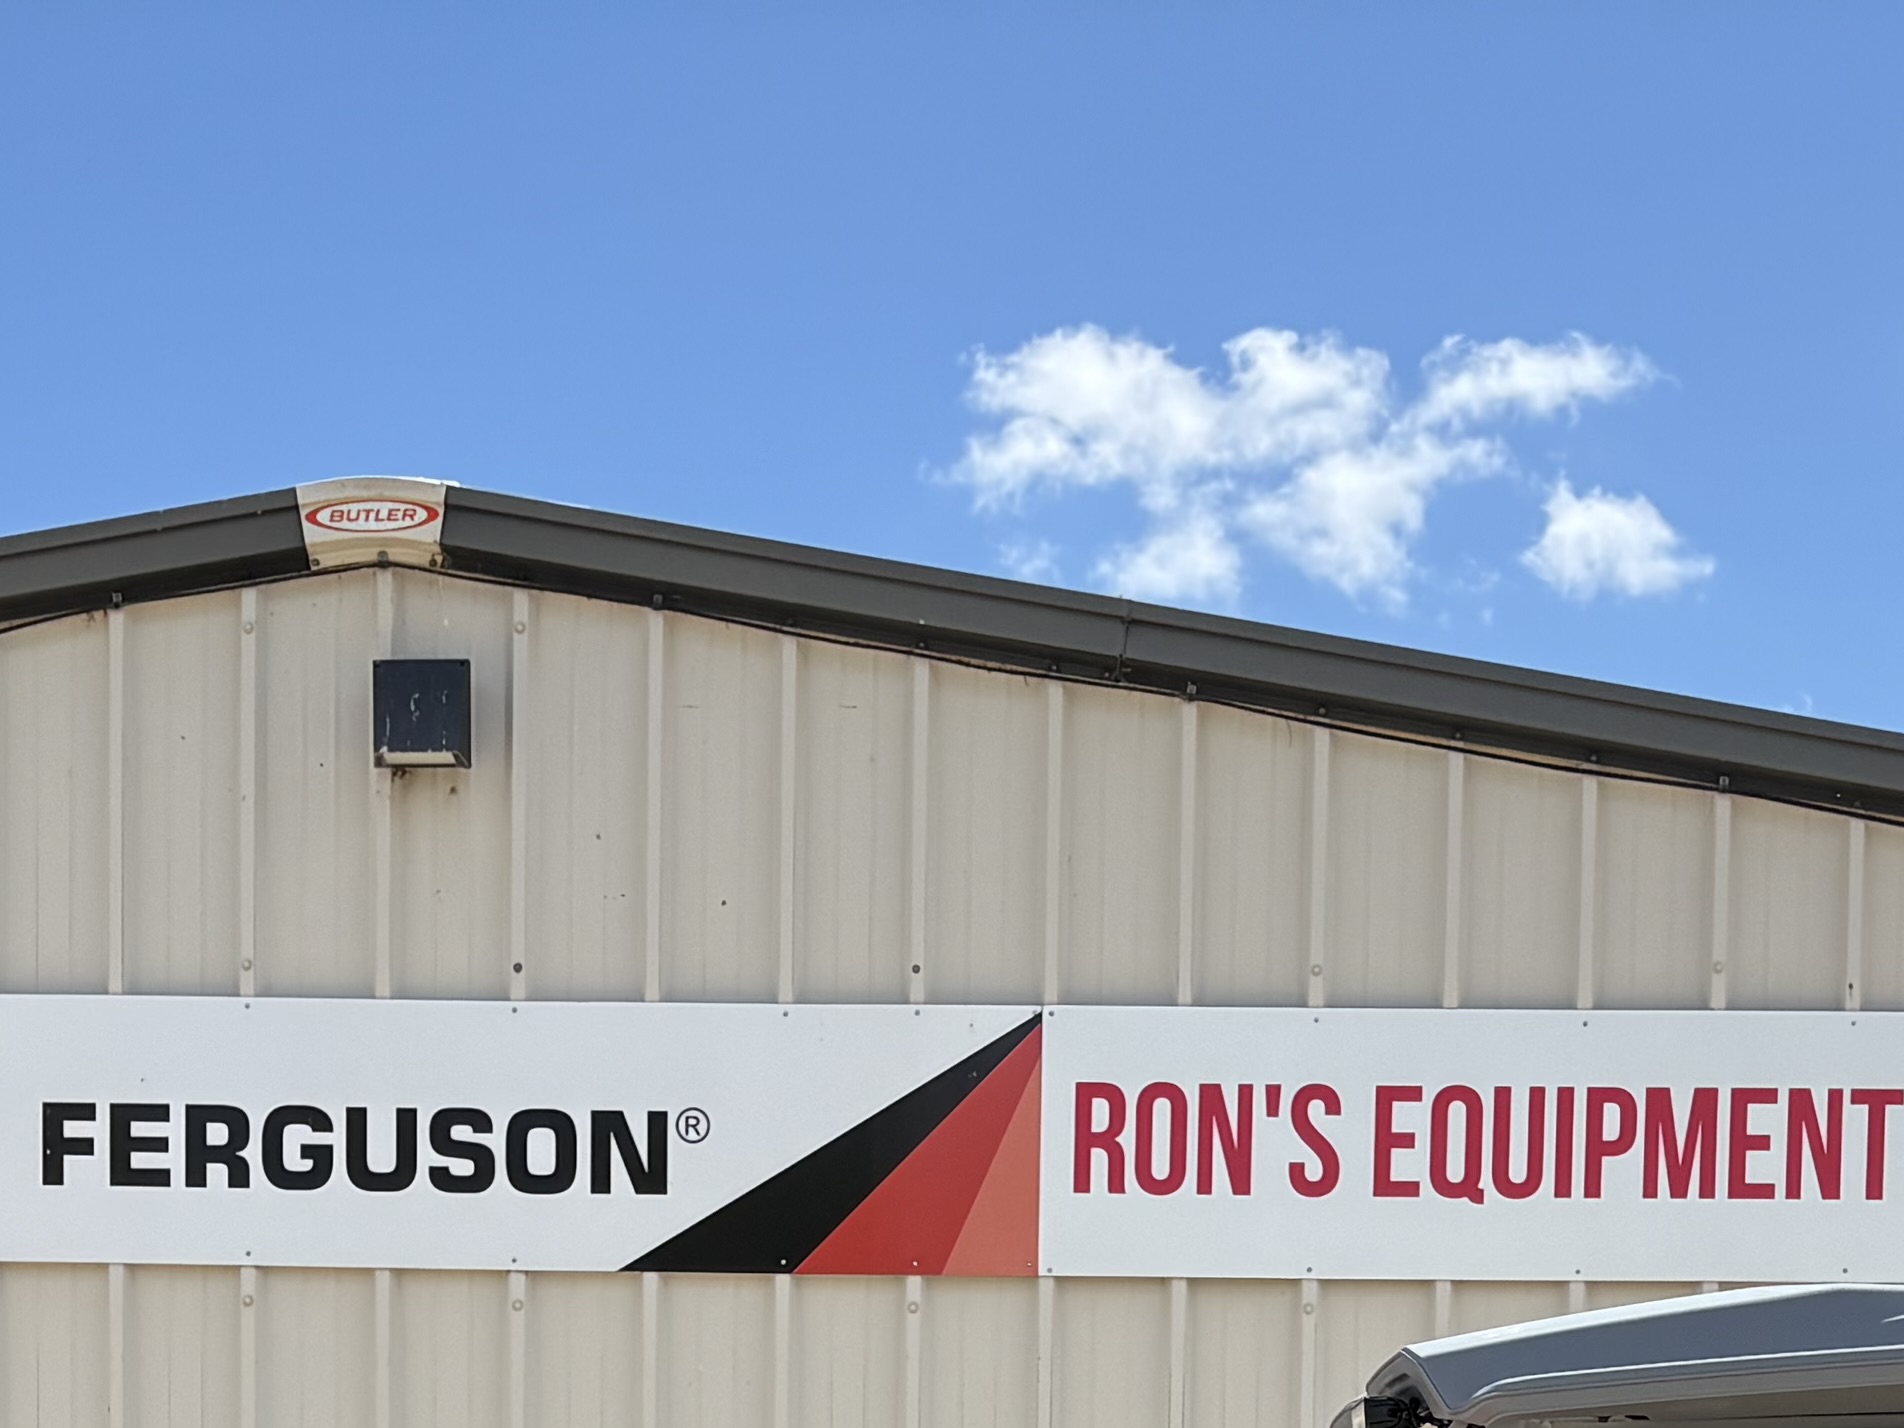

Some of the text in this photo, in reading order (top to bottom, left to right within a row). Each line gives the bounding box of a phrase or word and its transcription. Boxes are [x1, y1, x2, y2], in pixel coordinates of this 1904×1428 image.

[329, 508, 417, 523] BUTLER
[1072, 1082, 1342, 1197] RON'S
[1372, 1084, 1904, 1205] EQUIPMENT
